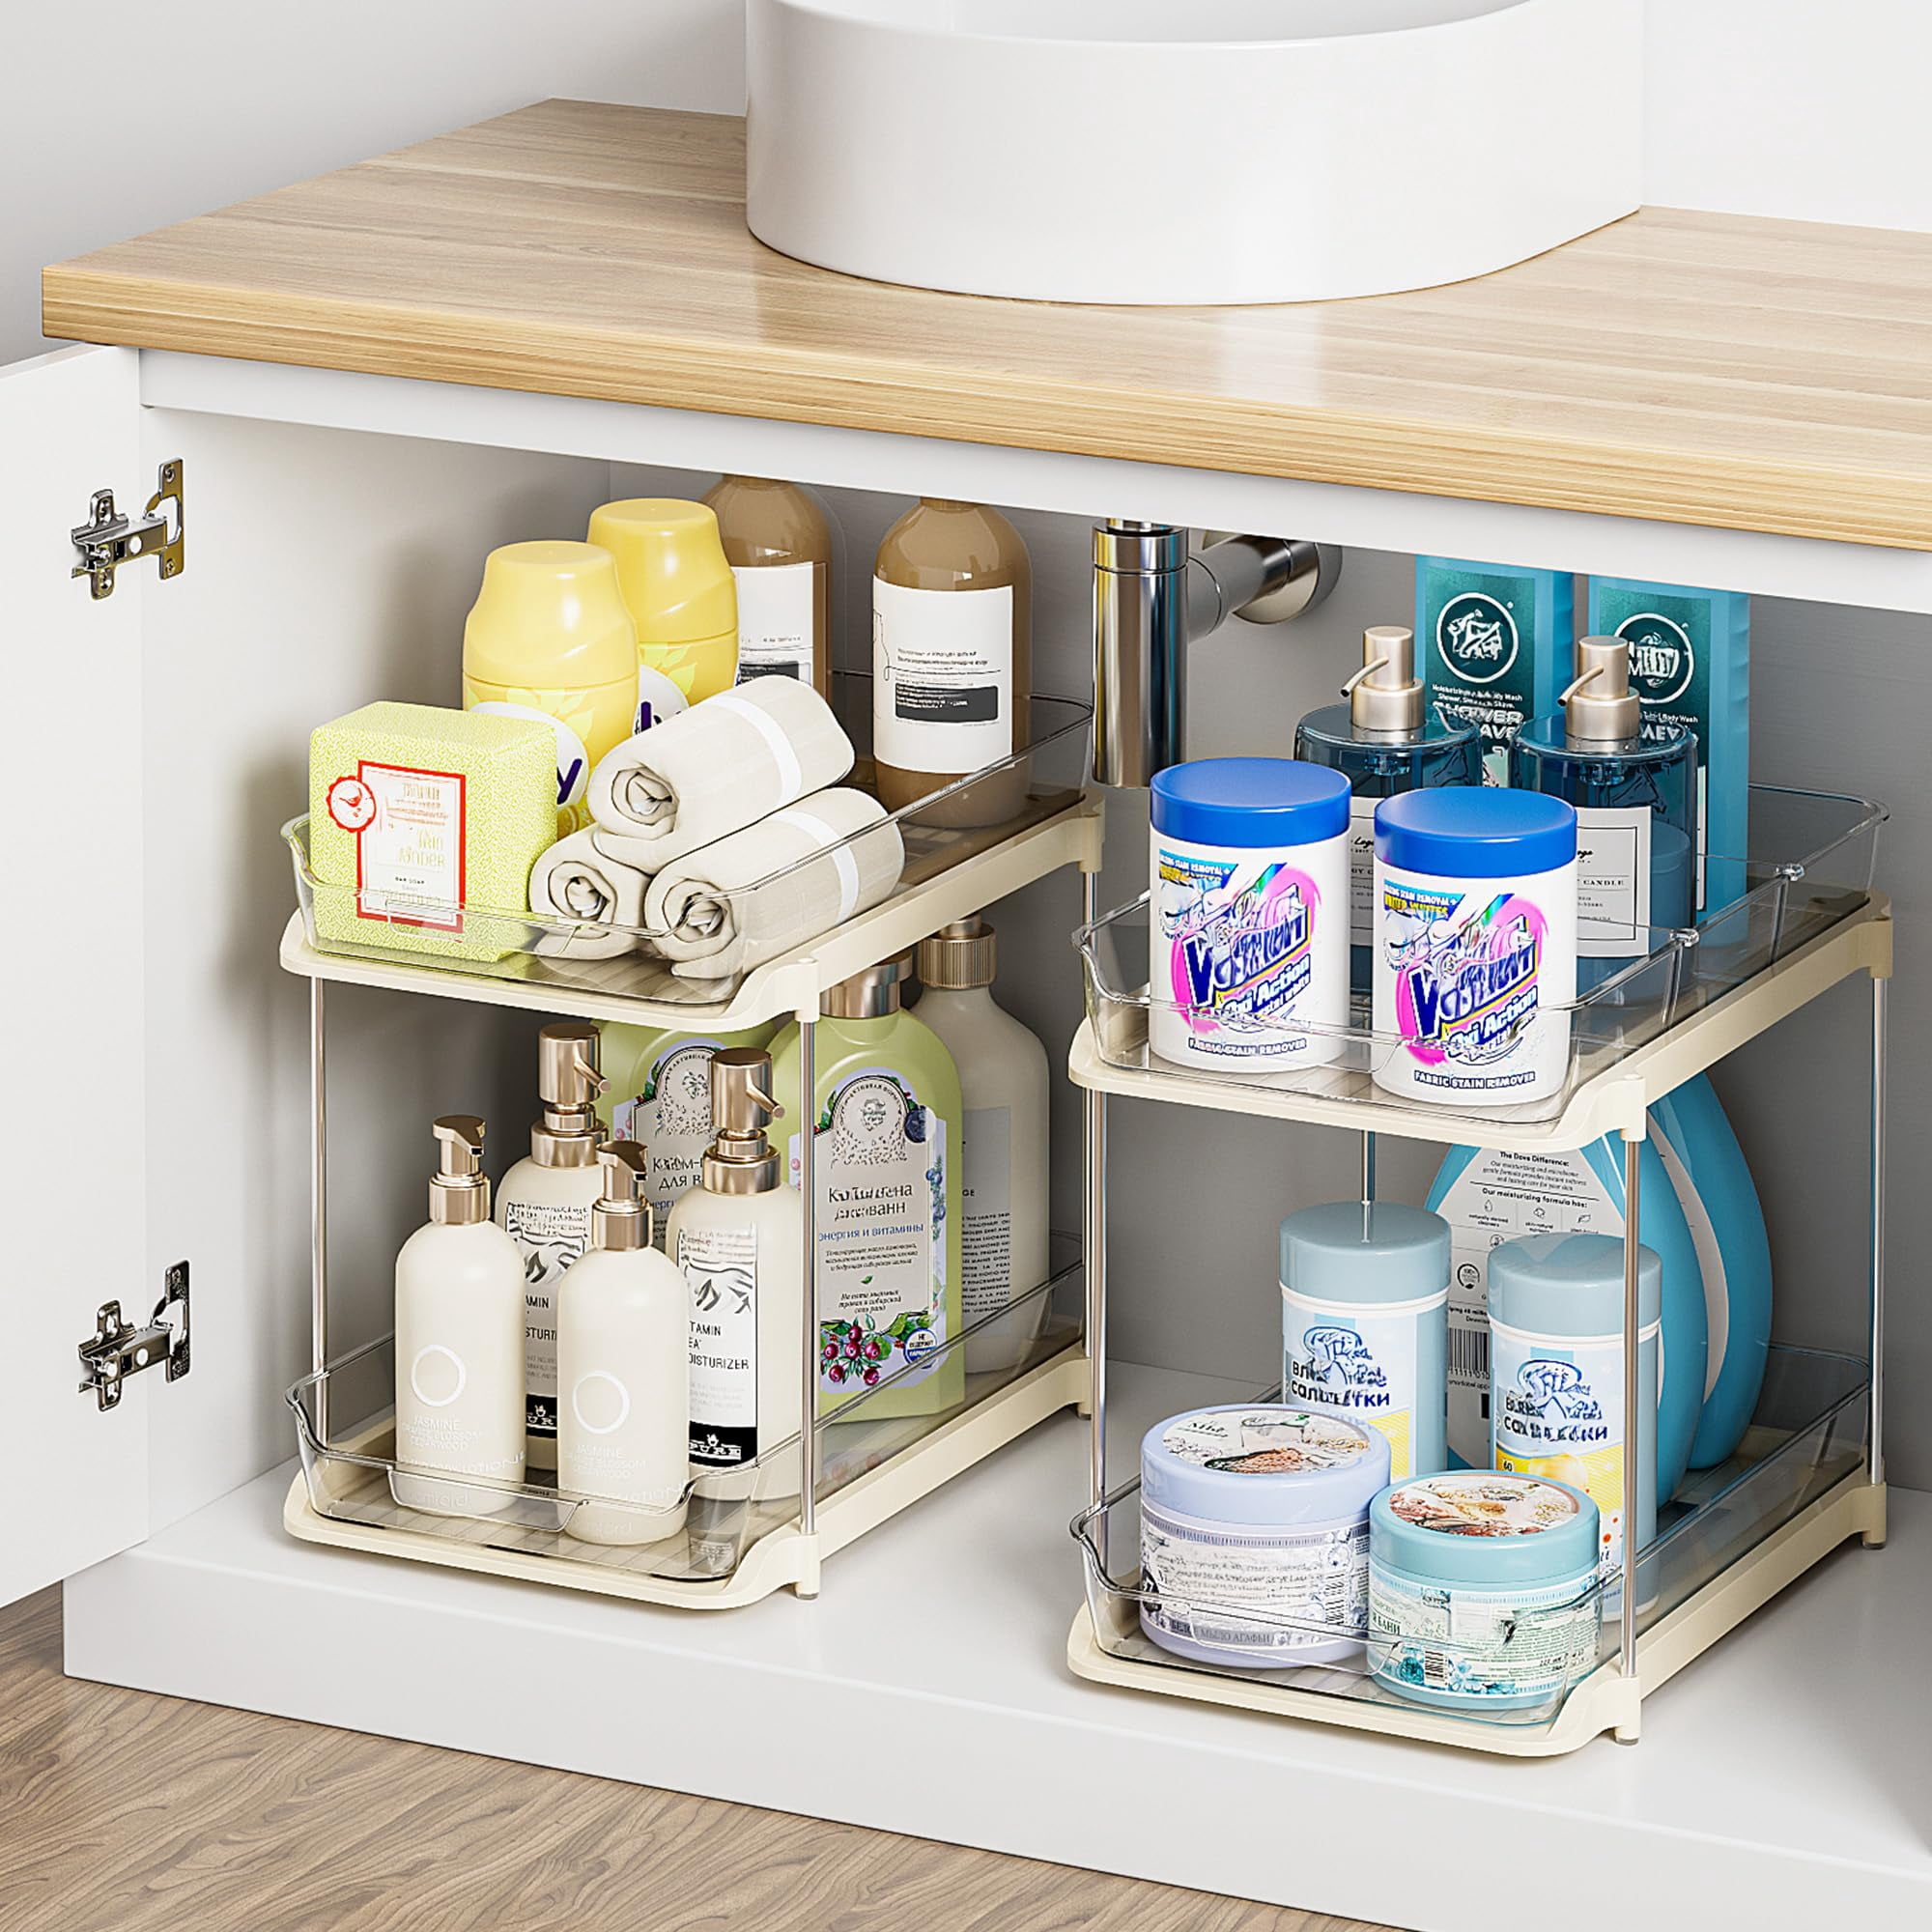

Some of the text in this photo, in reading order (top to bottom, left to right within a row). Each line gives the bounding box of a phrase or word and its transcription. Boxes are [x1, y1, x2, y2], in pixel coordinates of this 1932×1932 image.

[1257, 953, 1311, 1008] Action
[1483, 984, 1538, 1039] Action
[1259, 1037, 1307, 1056] REMOVER
[1414, 1069, 1536, 1089] FABRIC STAIN REMOVER
[1500, 1151, 1513, 1159] The
[689, 1320, 722, 1336] TAMIN
[689, 1352, 750, 1370] OISTURIZER
